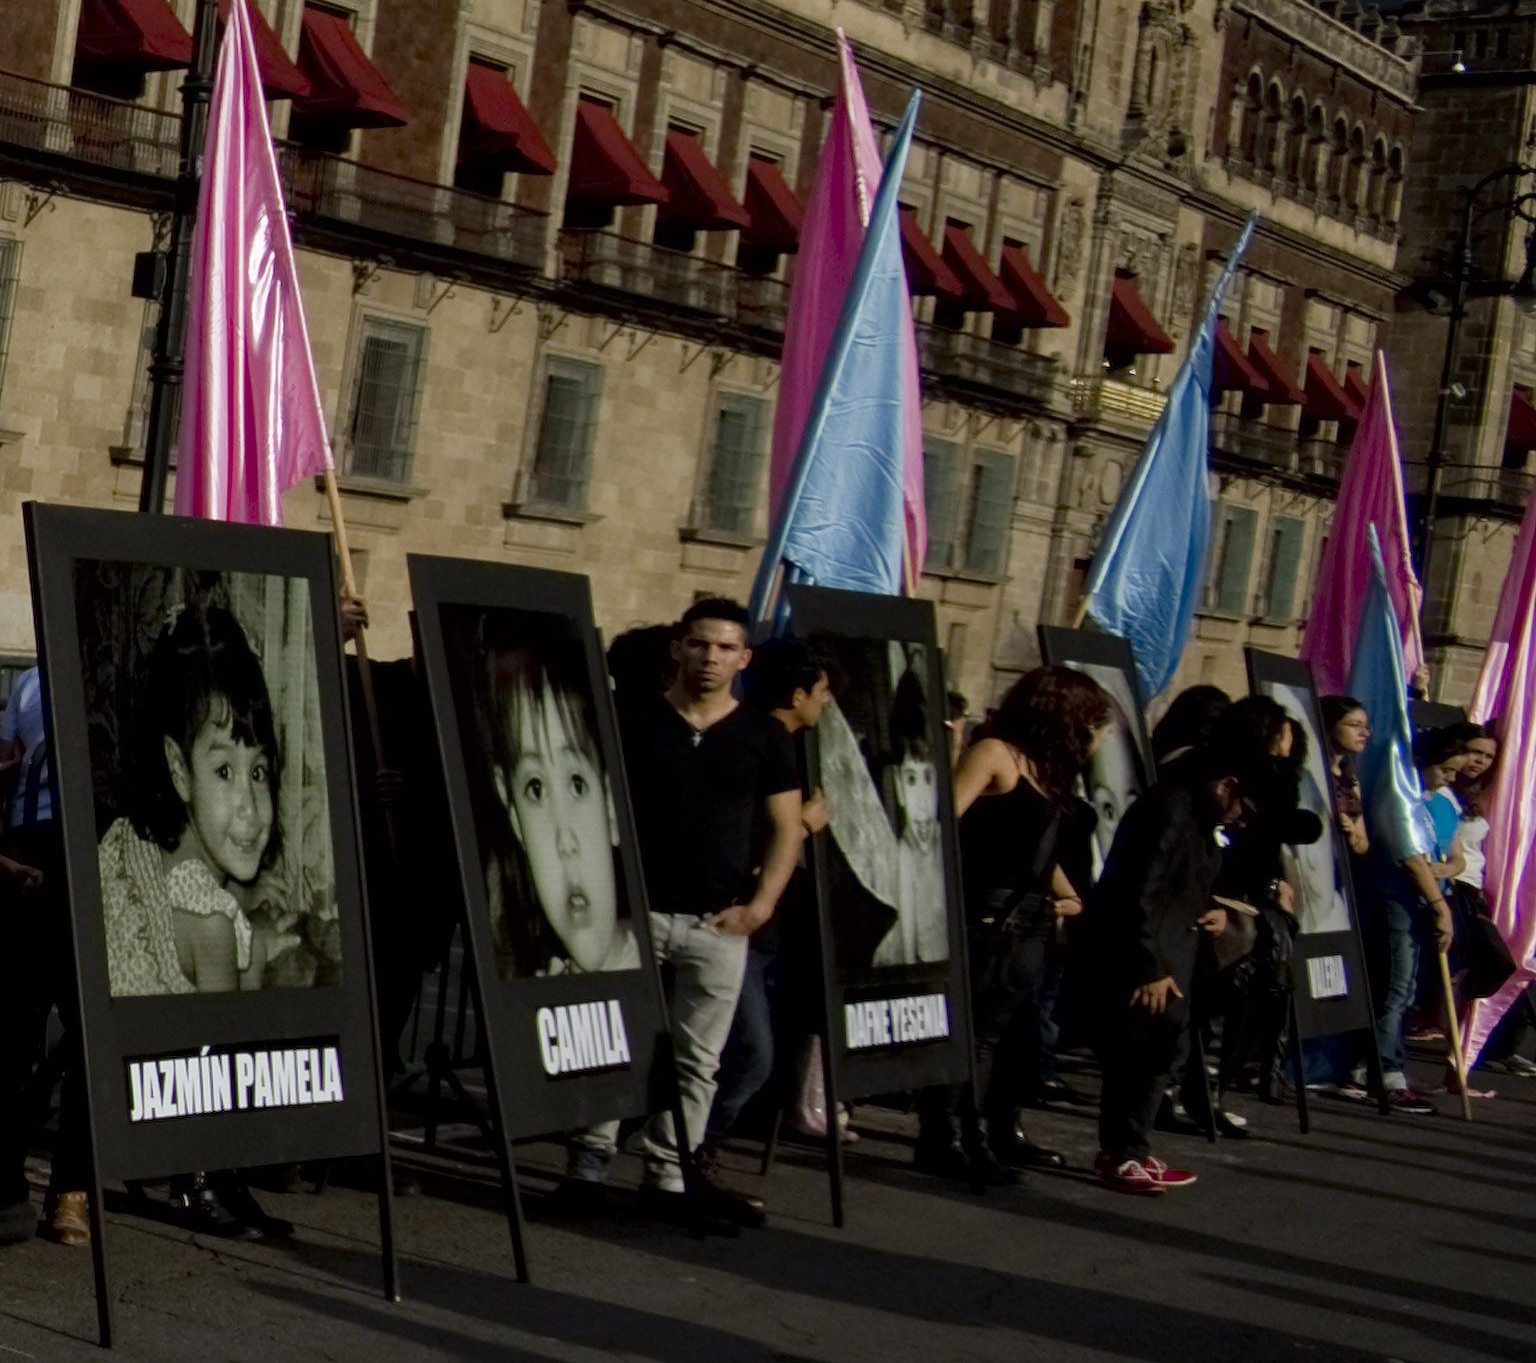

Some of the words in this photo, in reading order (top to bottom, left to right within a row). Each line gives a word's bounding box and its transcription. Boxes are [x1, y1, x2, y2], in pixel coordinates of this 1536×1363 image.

[536, 999, 631, 1075] CAMILA
[845, 1000, 892, 1048] DAFNE
[891, 994, 950, 1043] YESENIA
[129, 1045, 233, 1122] JAZMÍN
[235, 1047, 344, 1109] PAMELA
